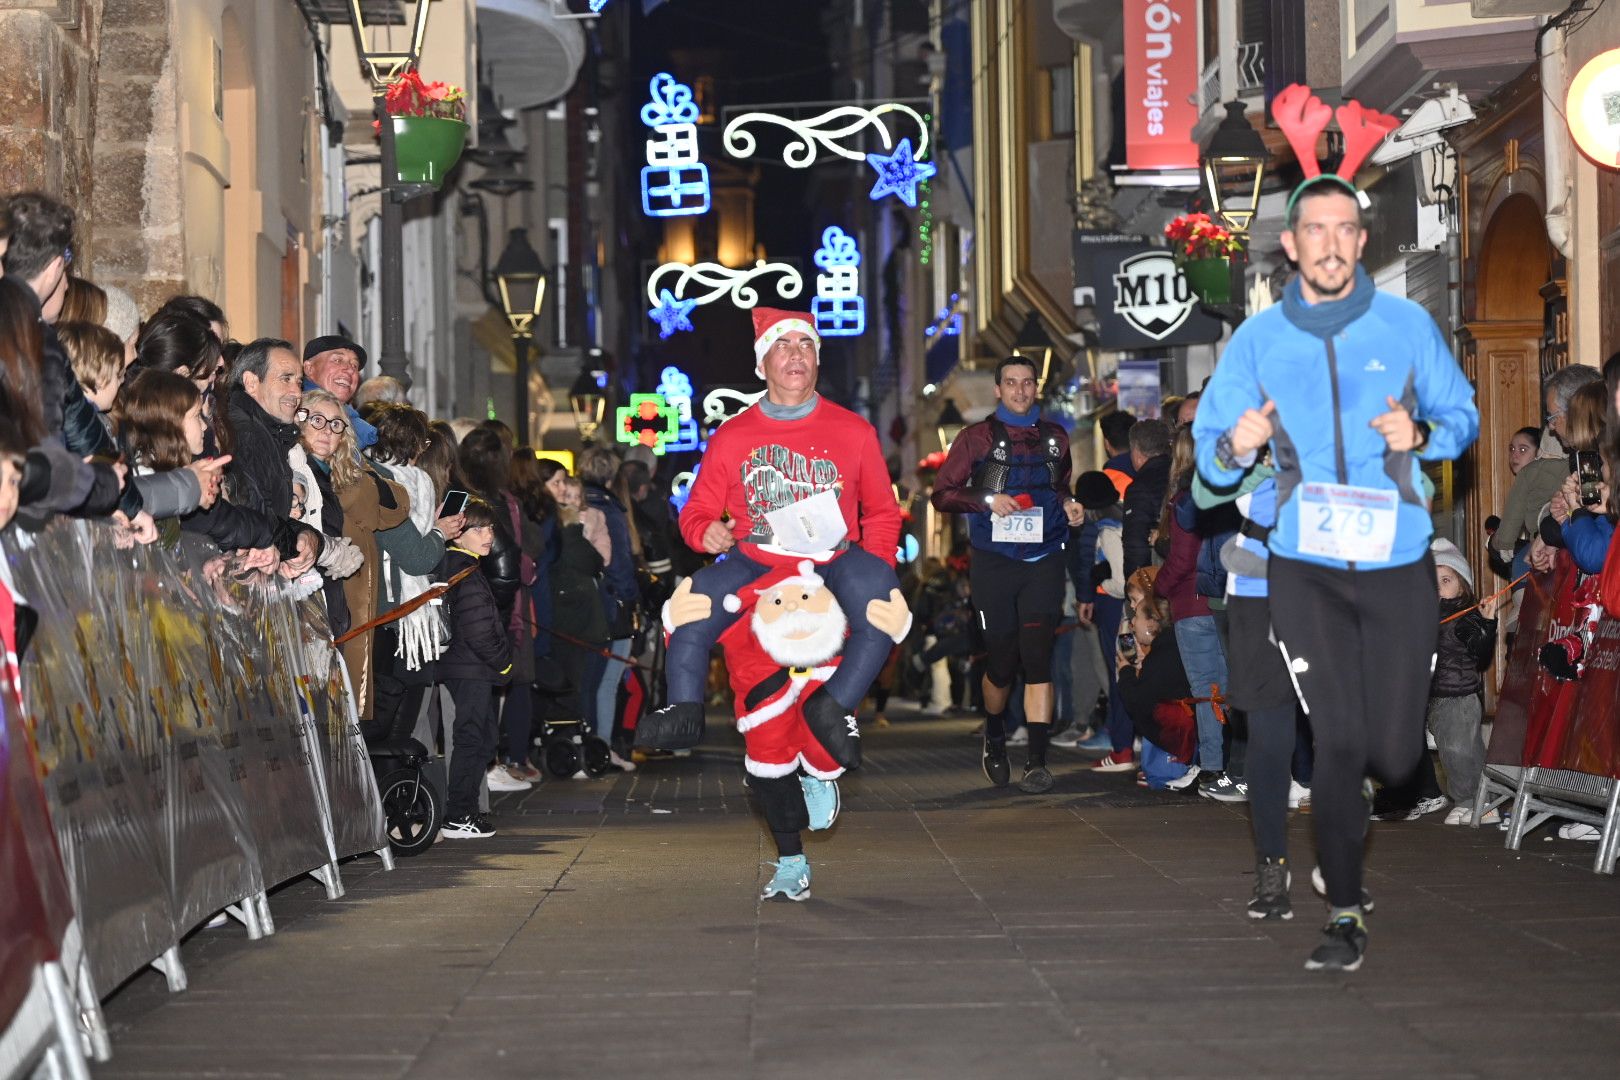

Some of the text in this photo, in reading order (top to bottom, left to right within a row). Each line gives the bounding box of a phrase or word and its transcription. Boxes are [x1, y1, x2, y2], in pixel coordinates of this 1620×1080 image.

[1143, 0, 1182, 137] ón viajes
[751, 444, 838, 485] SURVIVED
[1318, 506, 1374, 536] 279
